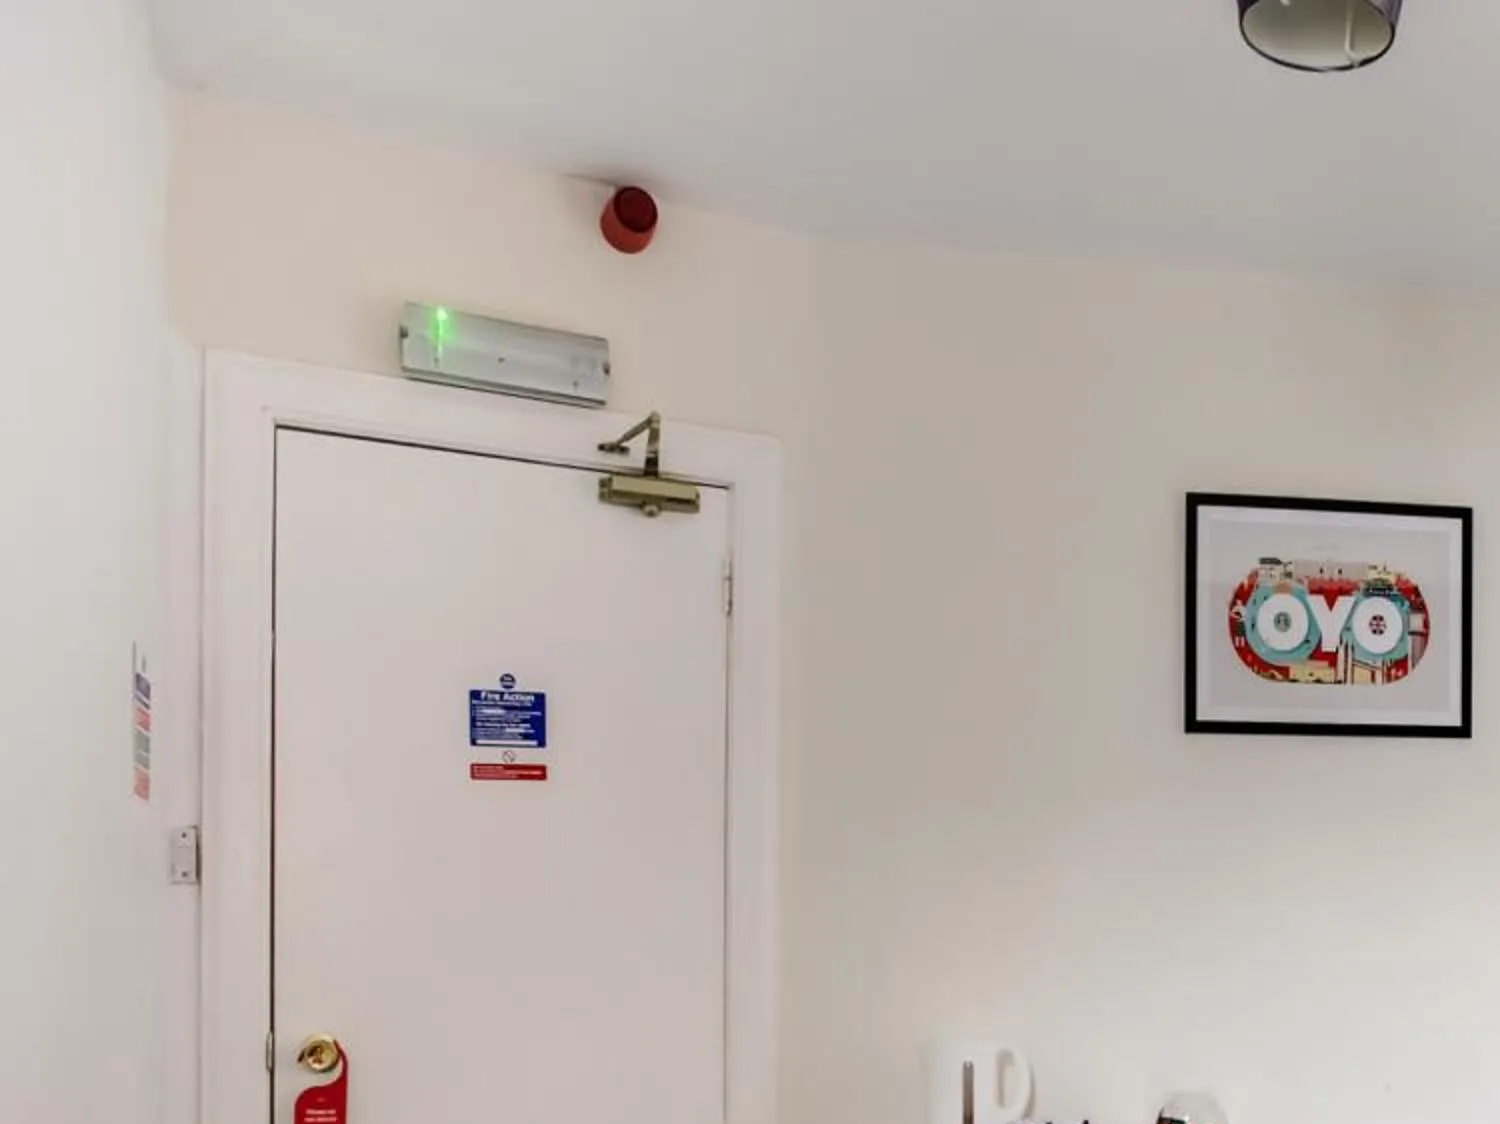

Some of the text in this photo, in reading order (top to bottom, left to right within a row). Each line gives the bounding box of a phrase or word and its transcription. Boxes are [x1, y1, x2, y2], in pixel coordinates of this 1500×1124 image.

[1257, 593, 1403, 654] OYO
[481, 691, 535, 702] Fire Action
